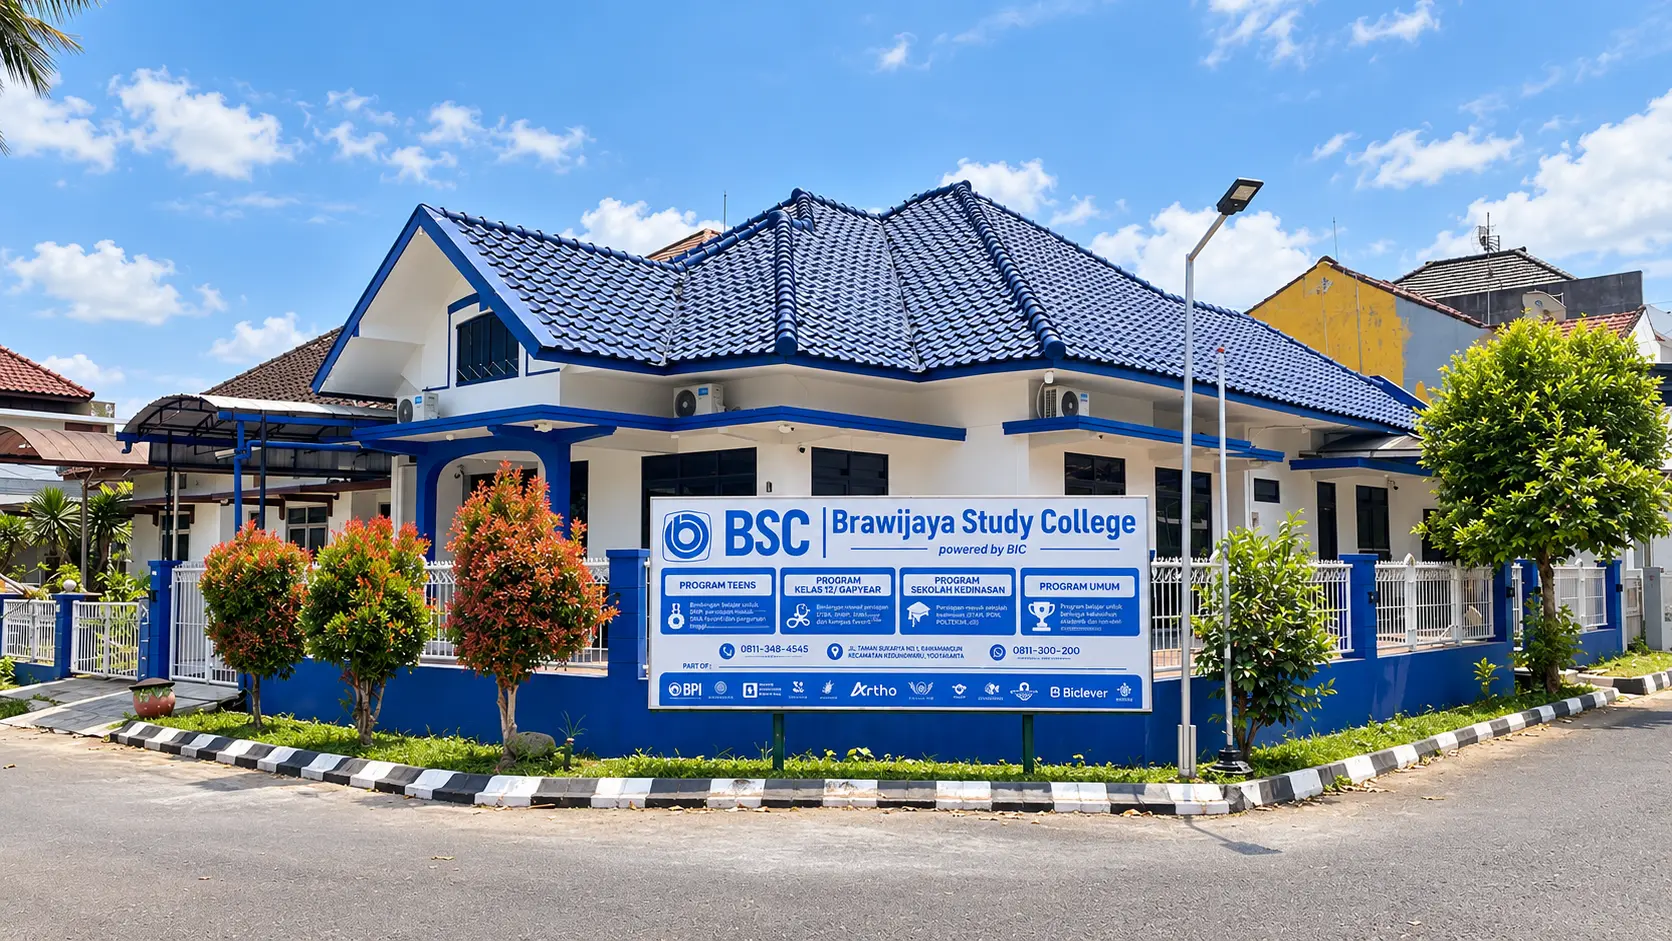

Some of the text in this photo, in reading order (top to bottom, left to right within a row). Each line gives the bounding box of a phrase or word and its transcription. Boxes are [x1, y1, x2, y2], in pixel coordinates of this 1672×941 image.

[832, 508, 1136, 541] Brawijaya Study College
[725, 508, 810, 557] BSC
[938, 544, 1027, 557] powered by BIC
[816, 576, 861, 585] PROGRAM
[934, 576, 980, 585] PROGRAM
[679, 581, 757, 590] PROGRAM TEENS
[794, 585, 823, 594] KELAS
[911, 585, 1006, 594] SEKOLAH KEDINASAN
[1039, 582, 1120, 591] PROGRAM UMUM
[1012, 645, 1081, 655] 0811-300-200
[682, 662, 699, 670] PART
[683, 682, 702, 696] BPI
[850, 681, 897, 697] Artho
[1063, 687, 1108, 698] Biclever
